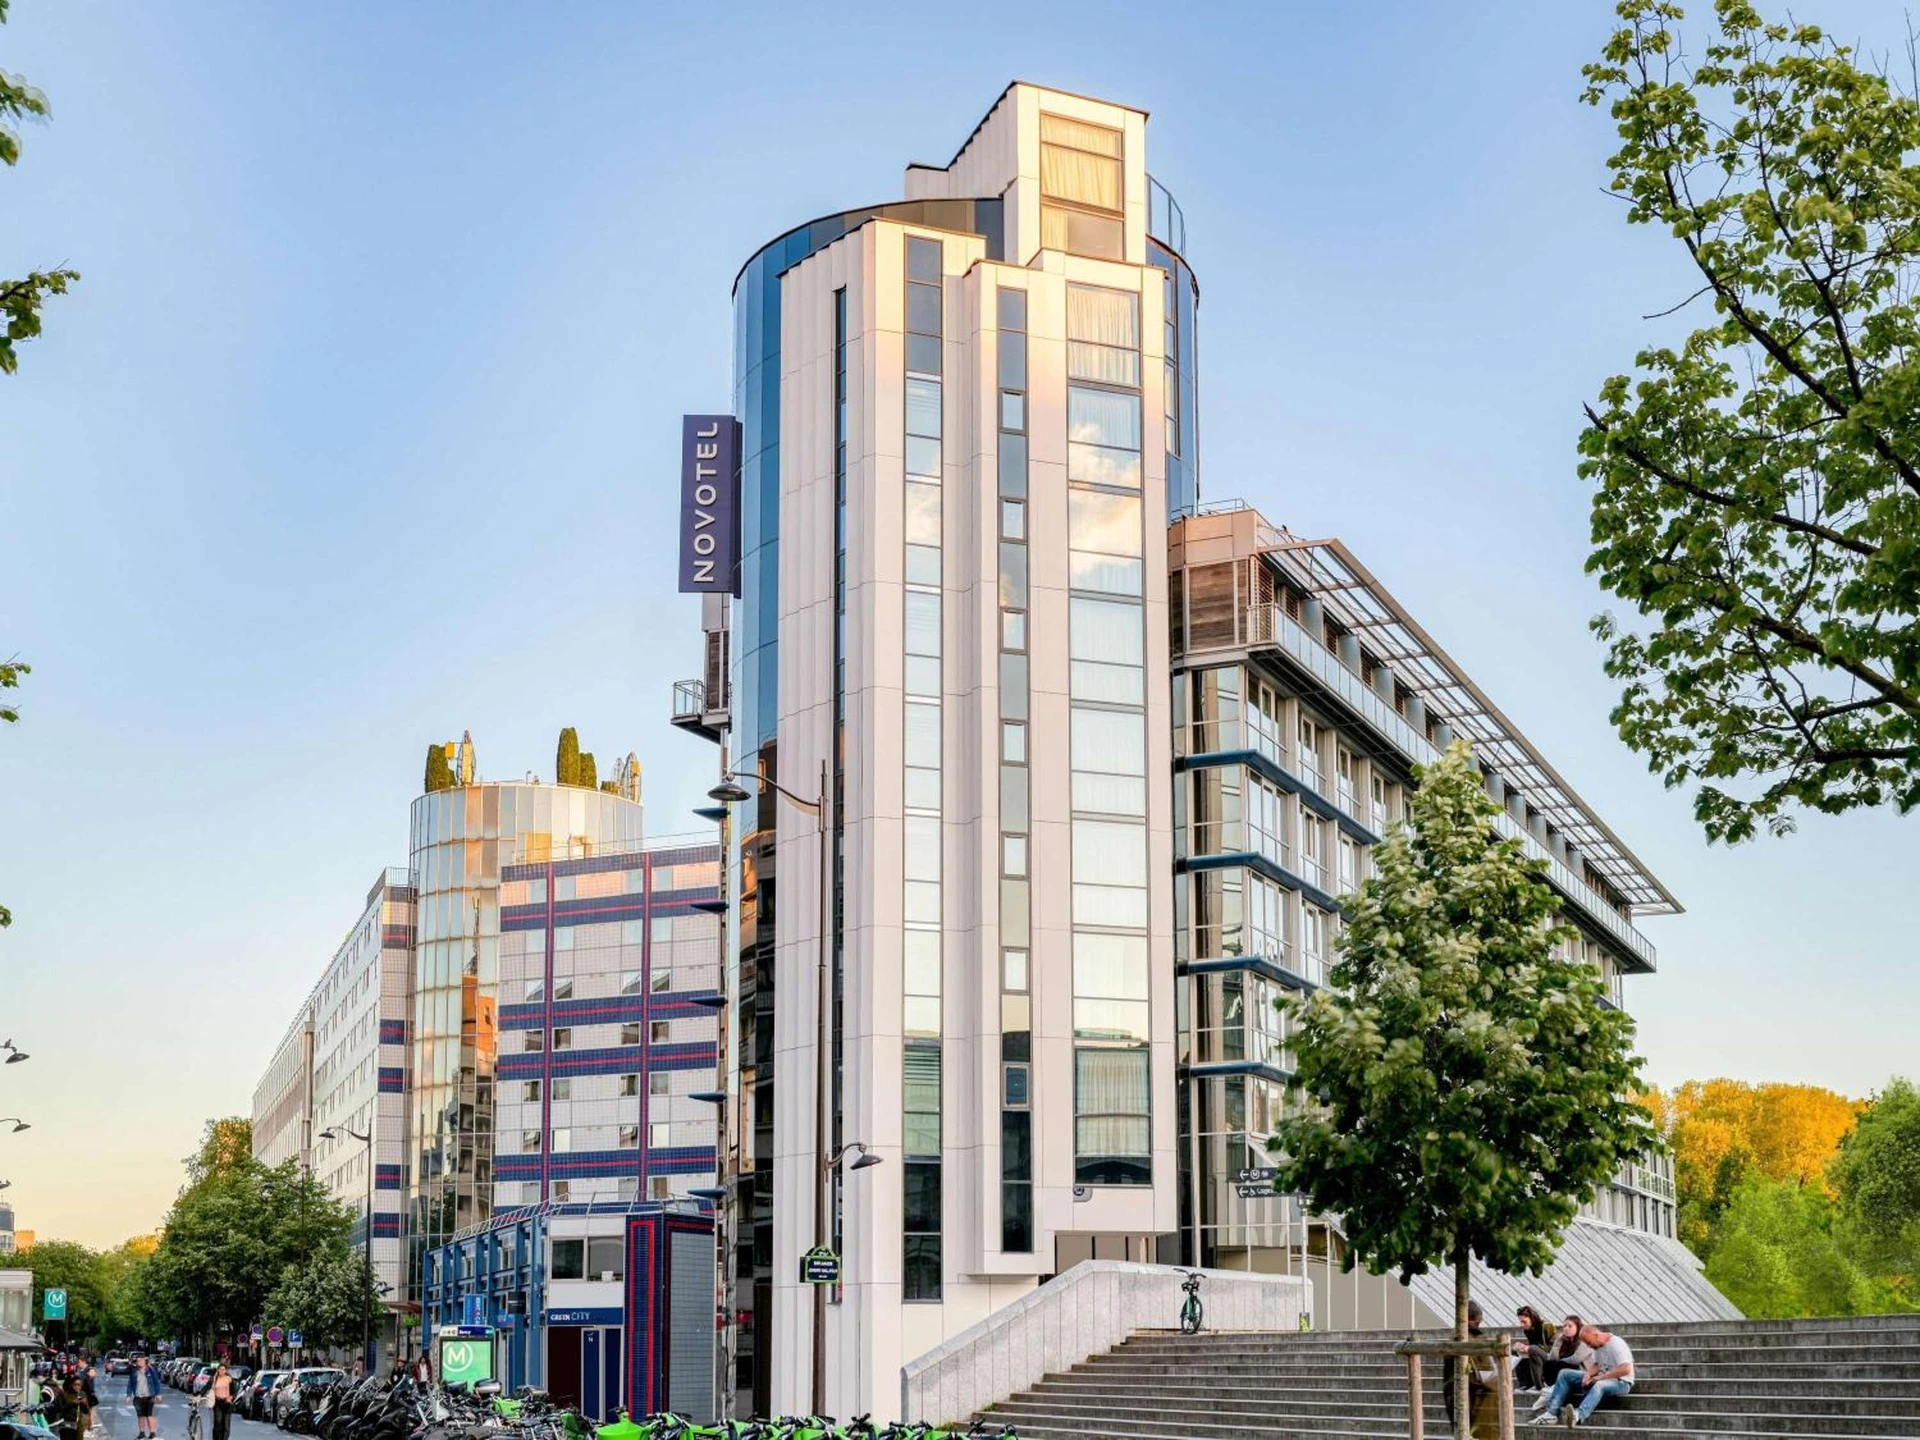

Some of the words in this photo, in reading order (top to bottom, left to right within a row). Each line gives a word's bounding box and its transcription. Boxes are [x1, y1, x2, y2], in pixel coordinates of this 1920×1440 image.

[693, 422, 718, 583] NOVOTEL
[52, 1293, 63, 1304] M
[571, 1311, 590, 1321] CITY
[448, 1346, 466, 1365] M
